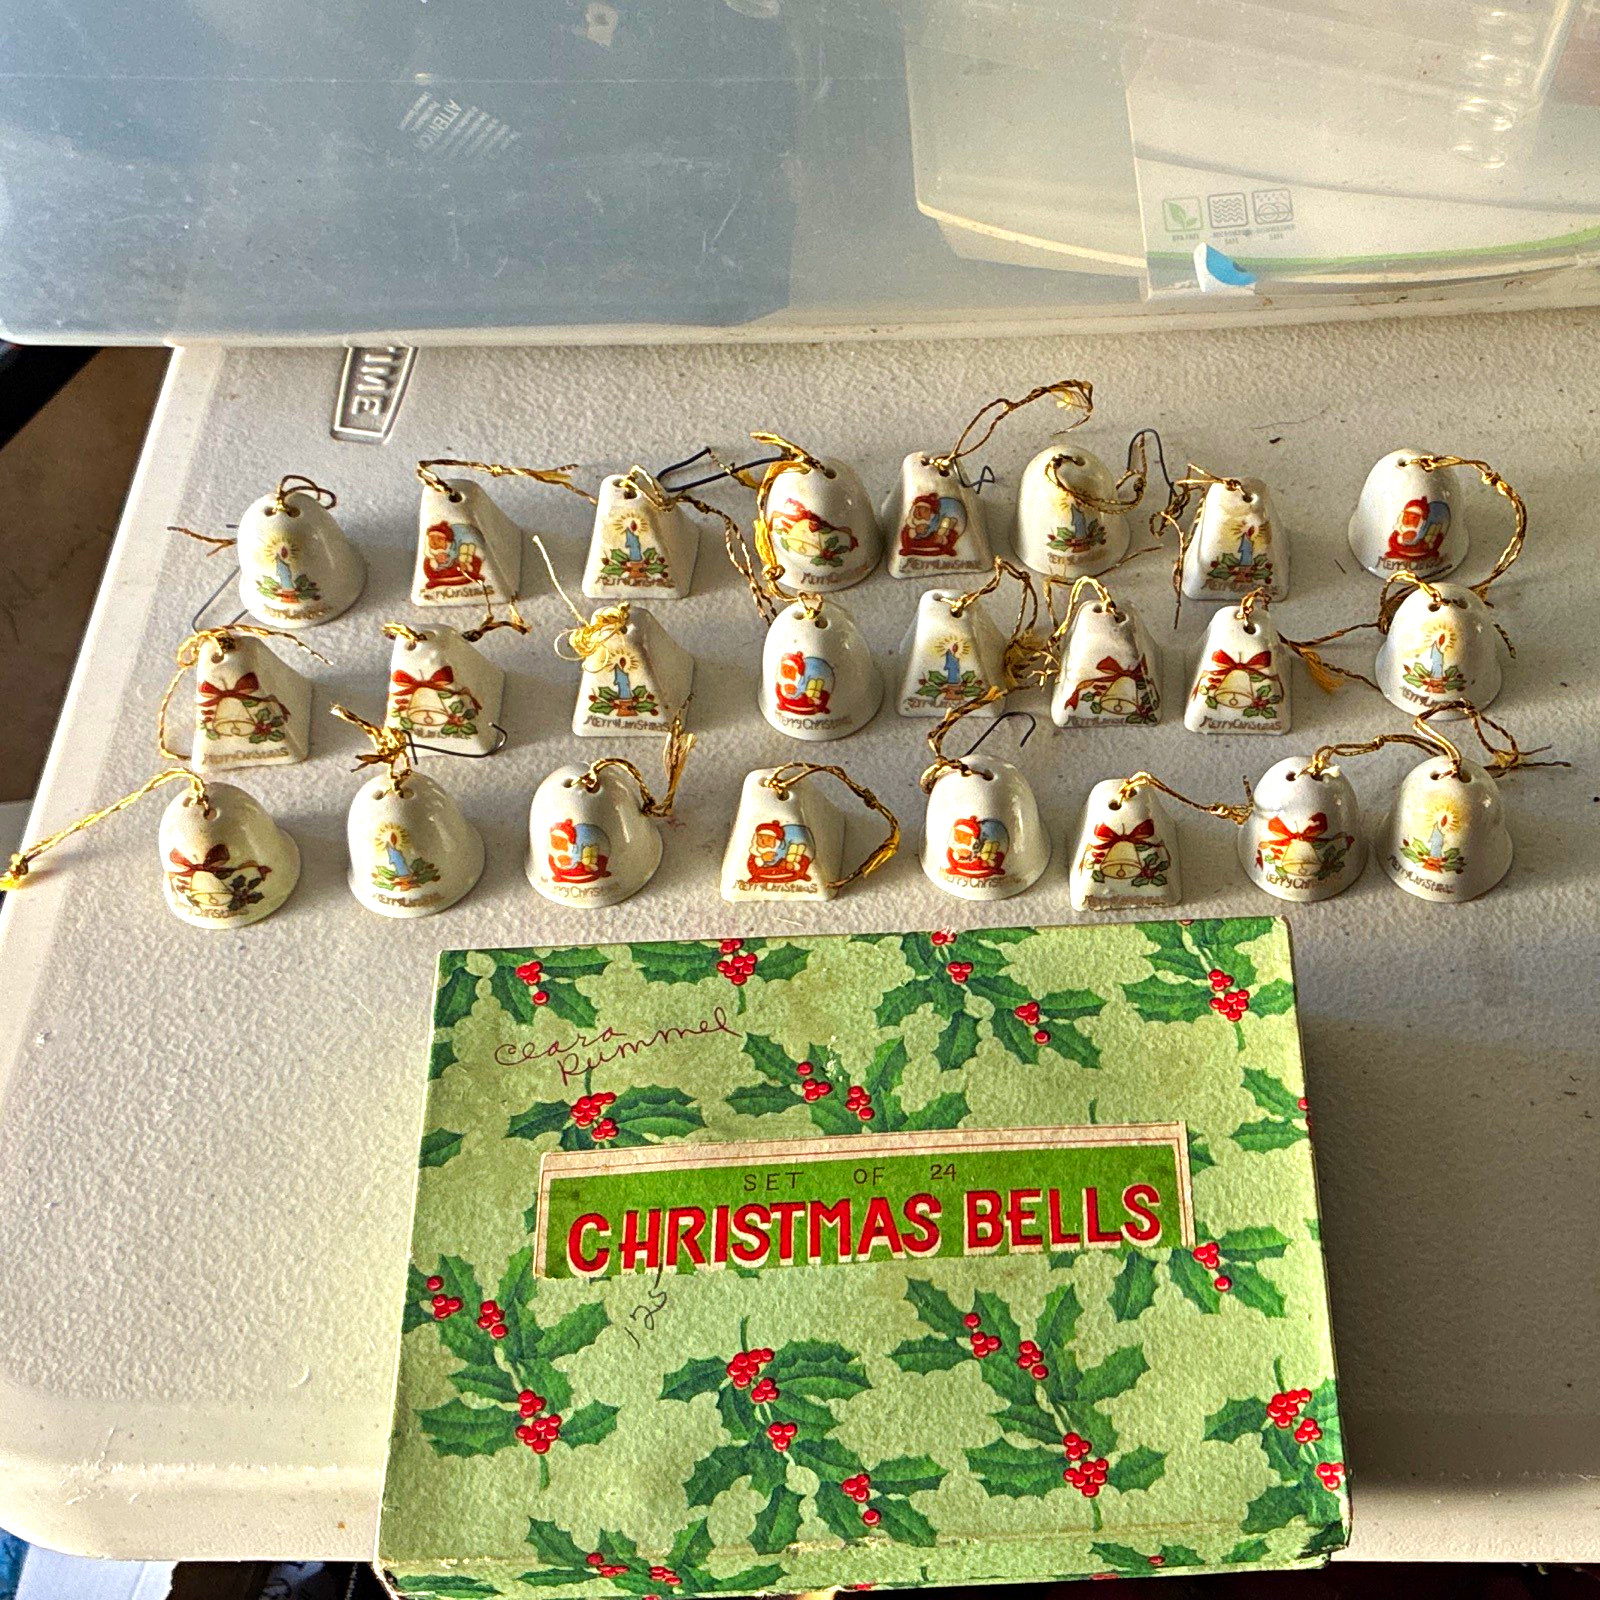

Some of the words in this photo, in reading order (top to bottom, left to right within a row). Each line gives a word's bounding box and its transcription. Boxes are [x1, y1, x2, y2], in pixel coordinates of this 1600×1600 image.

[351, 346, 396, 416] IME
[744, 1171, 804, 1191] SET
[853, 1166, 886, 1186] OF
[930, 1163, 958, 1183] 24
[566, 1194, 942, 1278] CHRISTMAS
[964, 1184, 1164, 1256] BELLS
